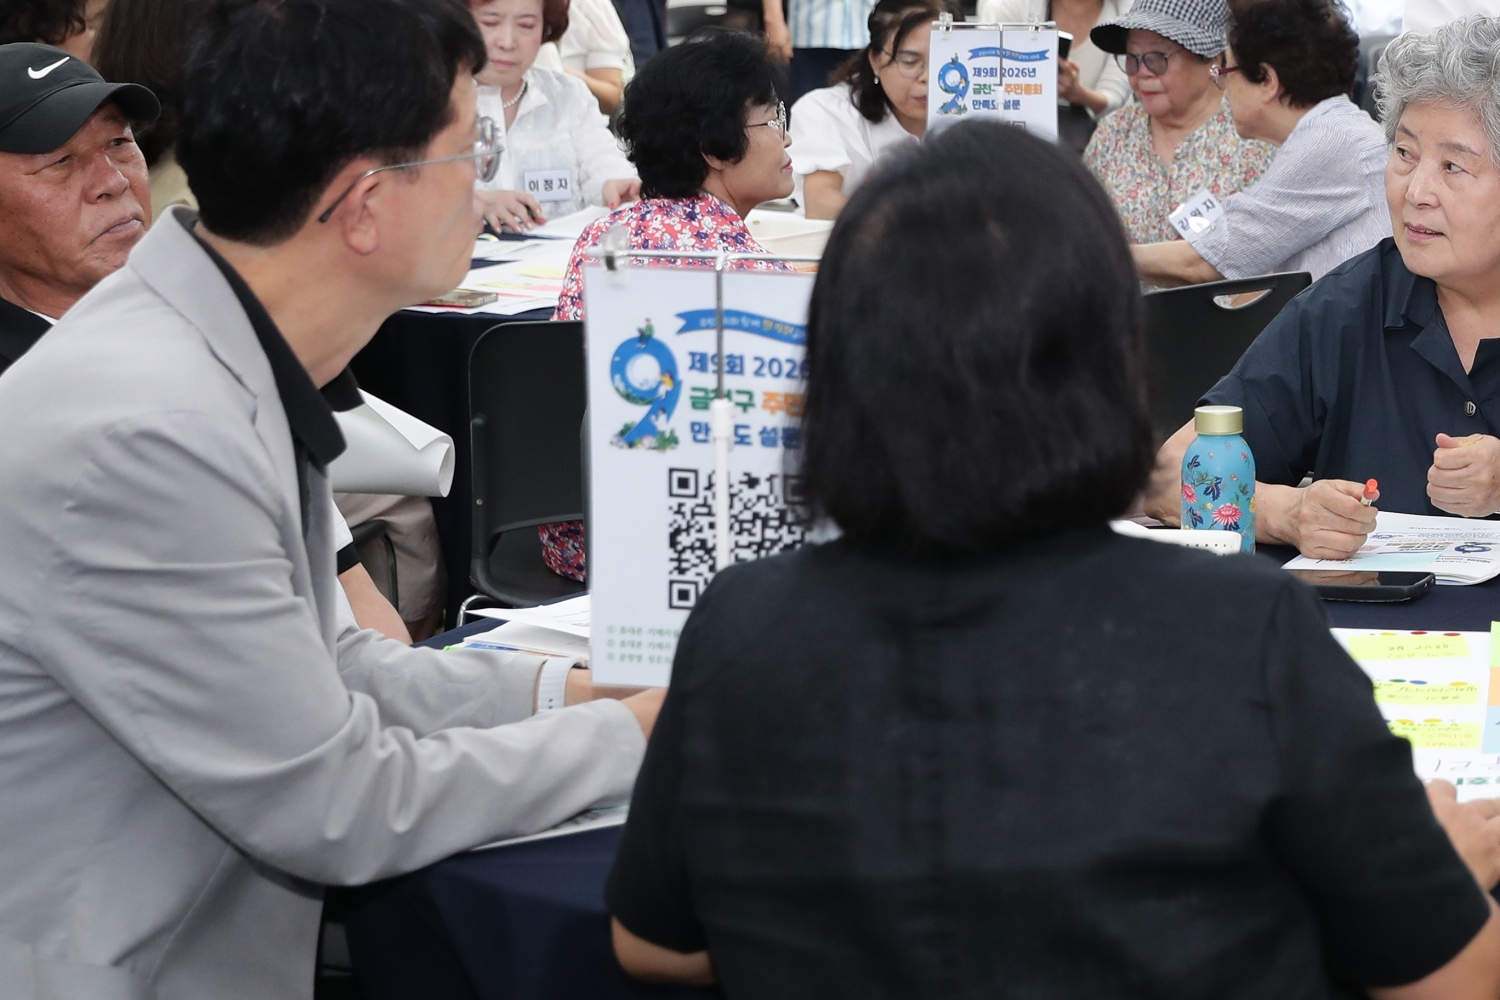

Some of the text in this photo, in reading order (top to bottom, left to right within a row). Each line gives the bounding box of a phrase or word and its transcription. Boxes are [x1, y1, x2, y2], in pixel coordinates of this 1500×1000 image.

[972, 67, 1037, 78] 제9회 2026년
[1004, 83, 1043, 96] 주민총회
[1003, 99, 1021, 111] 설문
[689, 421, 753, 447] 만도
